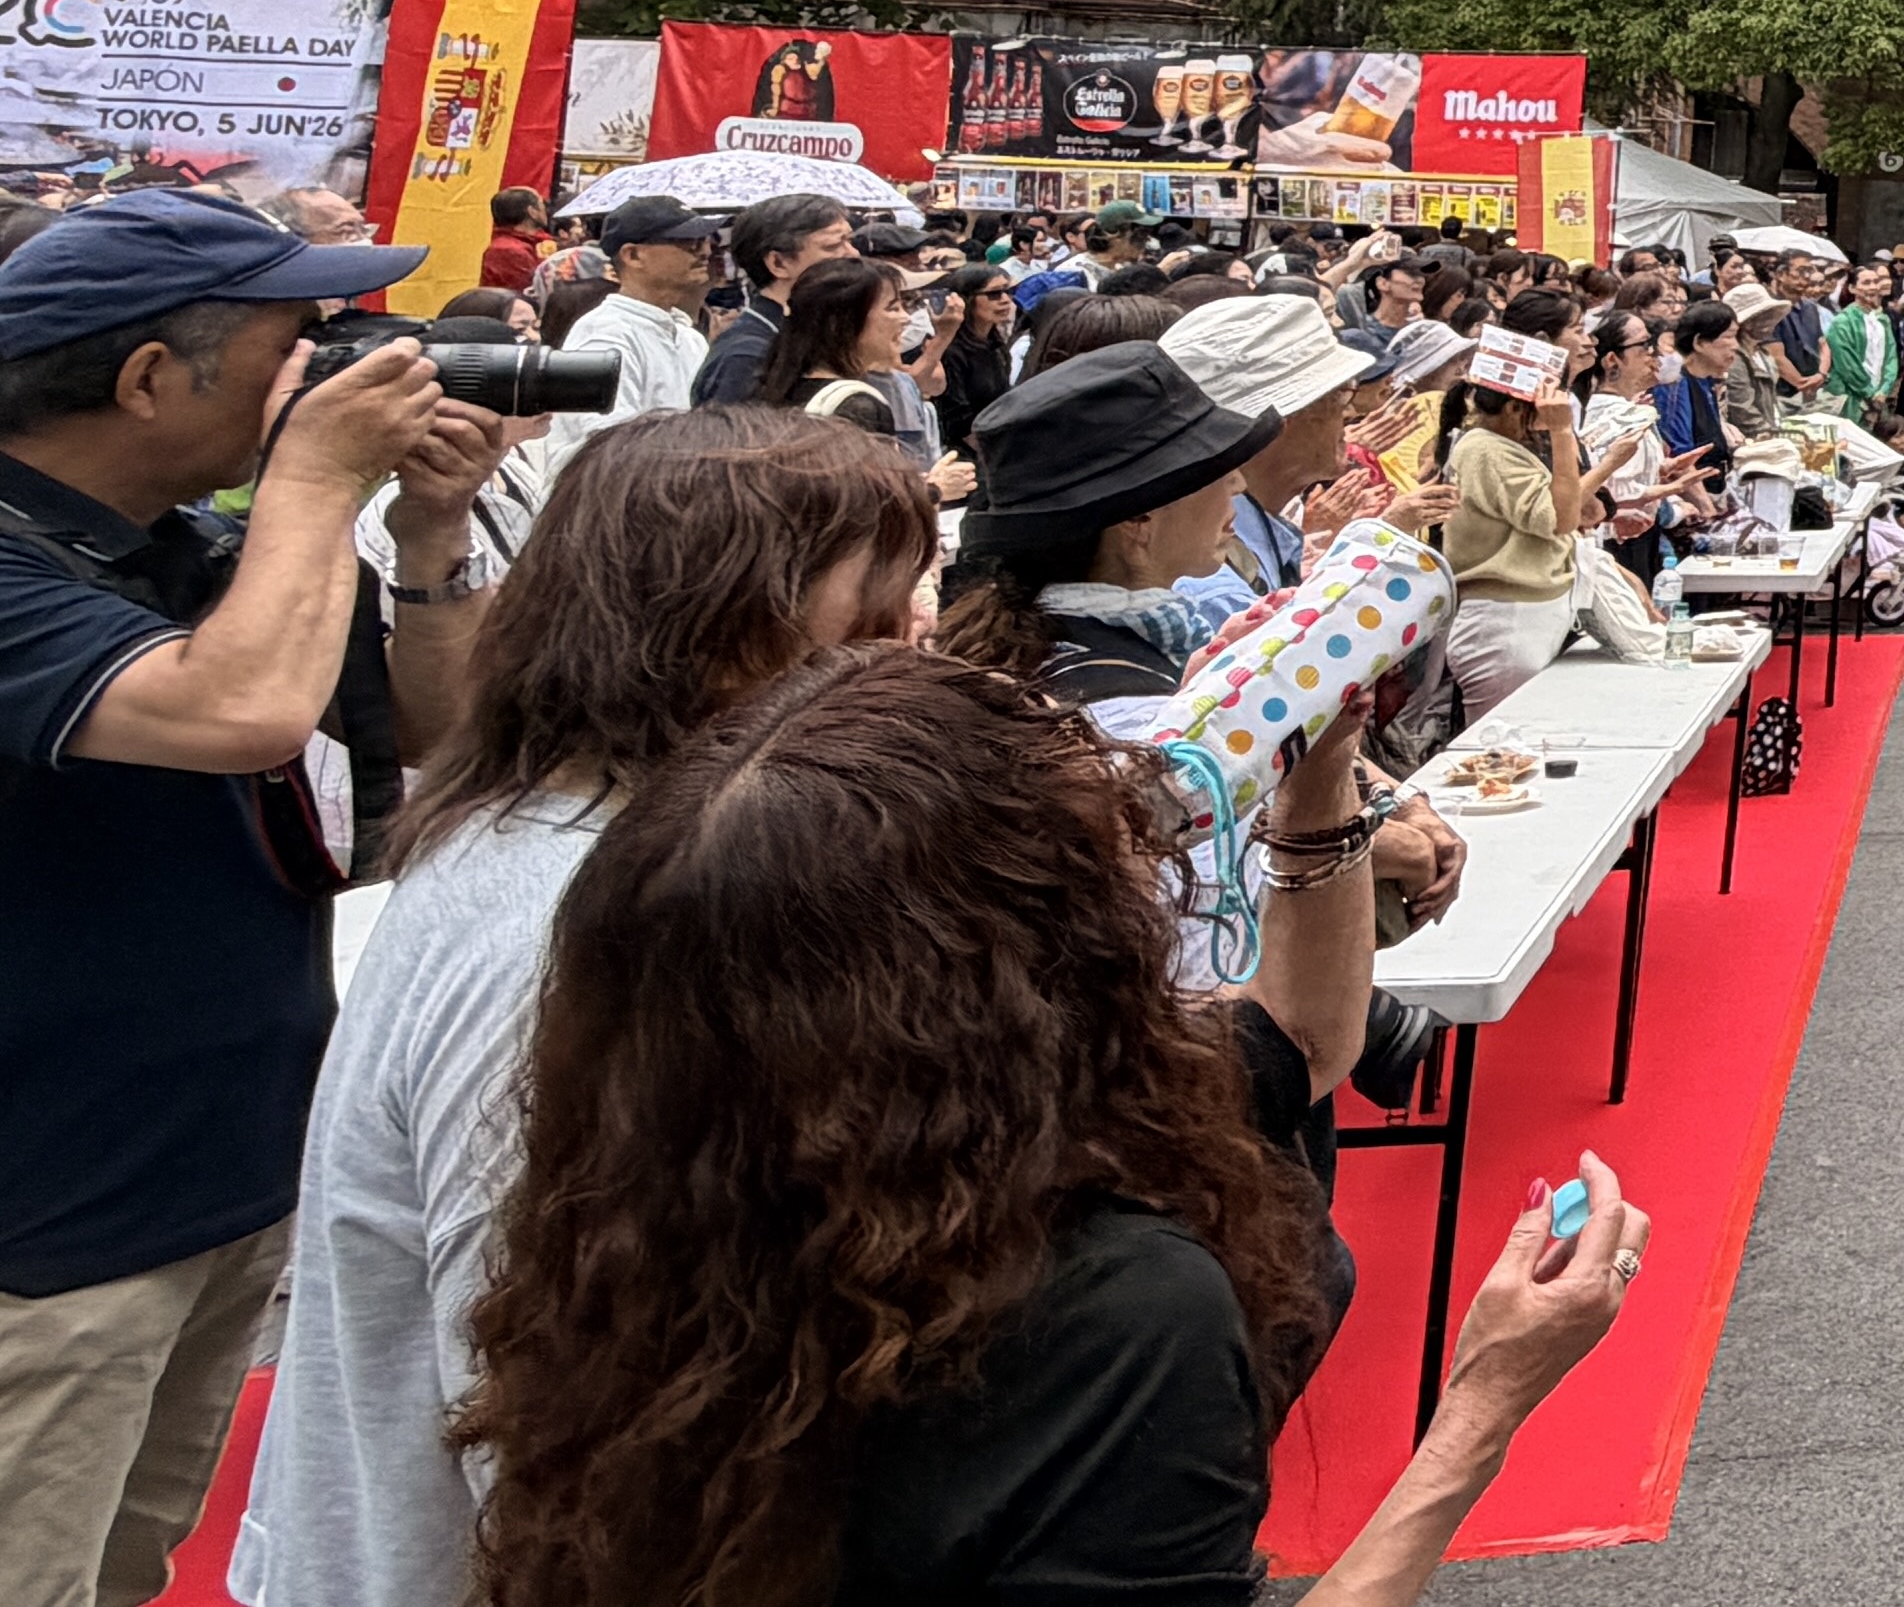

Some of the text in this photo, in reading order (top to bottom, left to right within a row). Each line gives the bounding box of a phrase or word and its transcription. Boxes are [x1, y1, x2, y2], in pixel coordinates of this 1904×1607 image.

[103, 7, 231, 32] VALENCIA
[102, 29, 357, 58] WORLD PAELLA DAY
[100, 63, 204, 93] JAPÓN
[1443, 89, 1559, 123] Mahou
[98, 107, 205, 137] TOKYO,
[216, 112, 236, 134] 5
[726, 124, 854, 157] Cruzcampo
